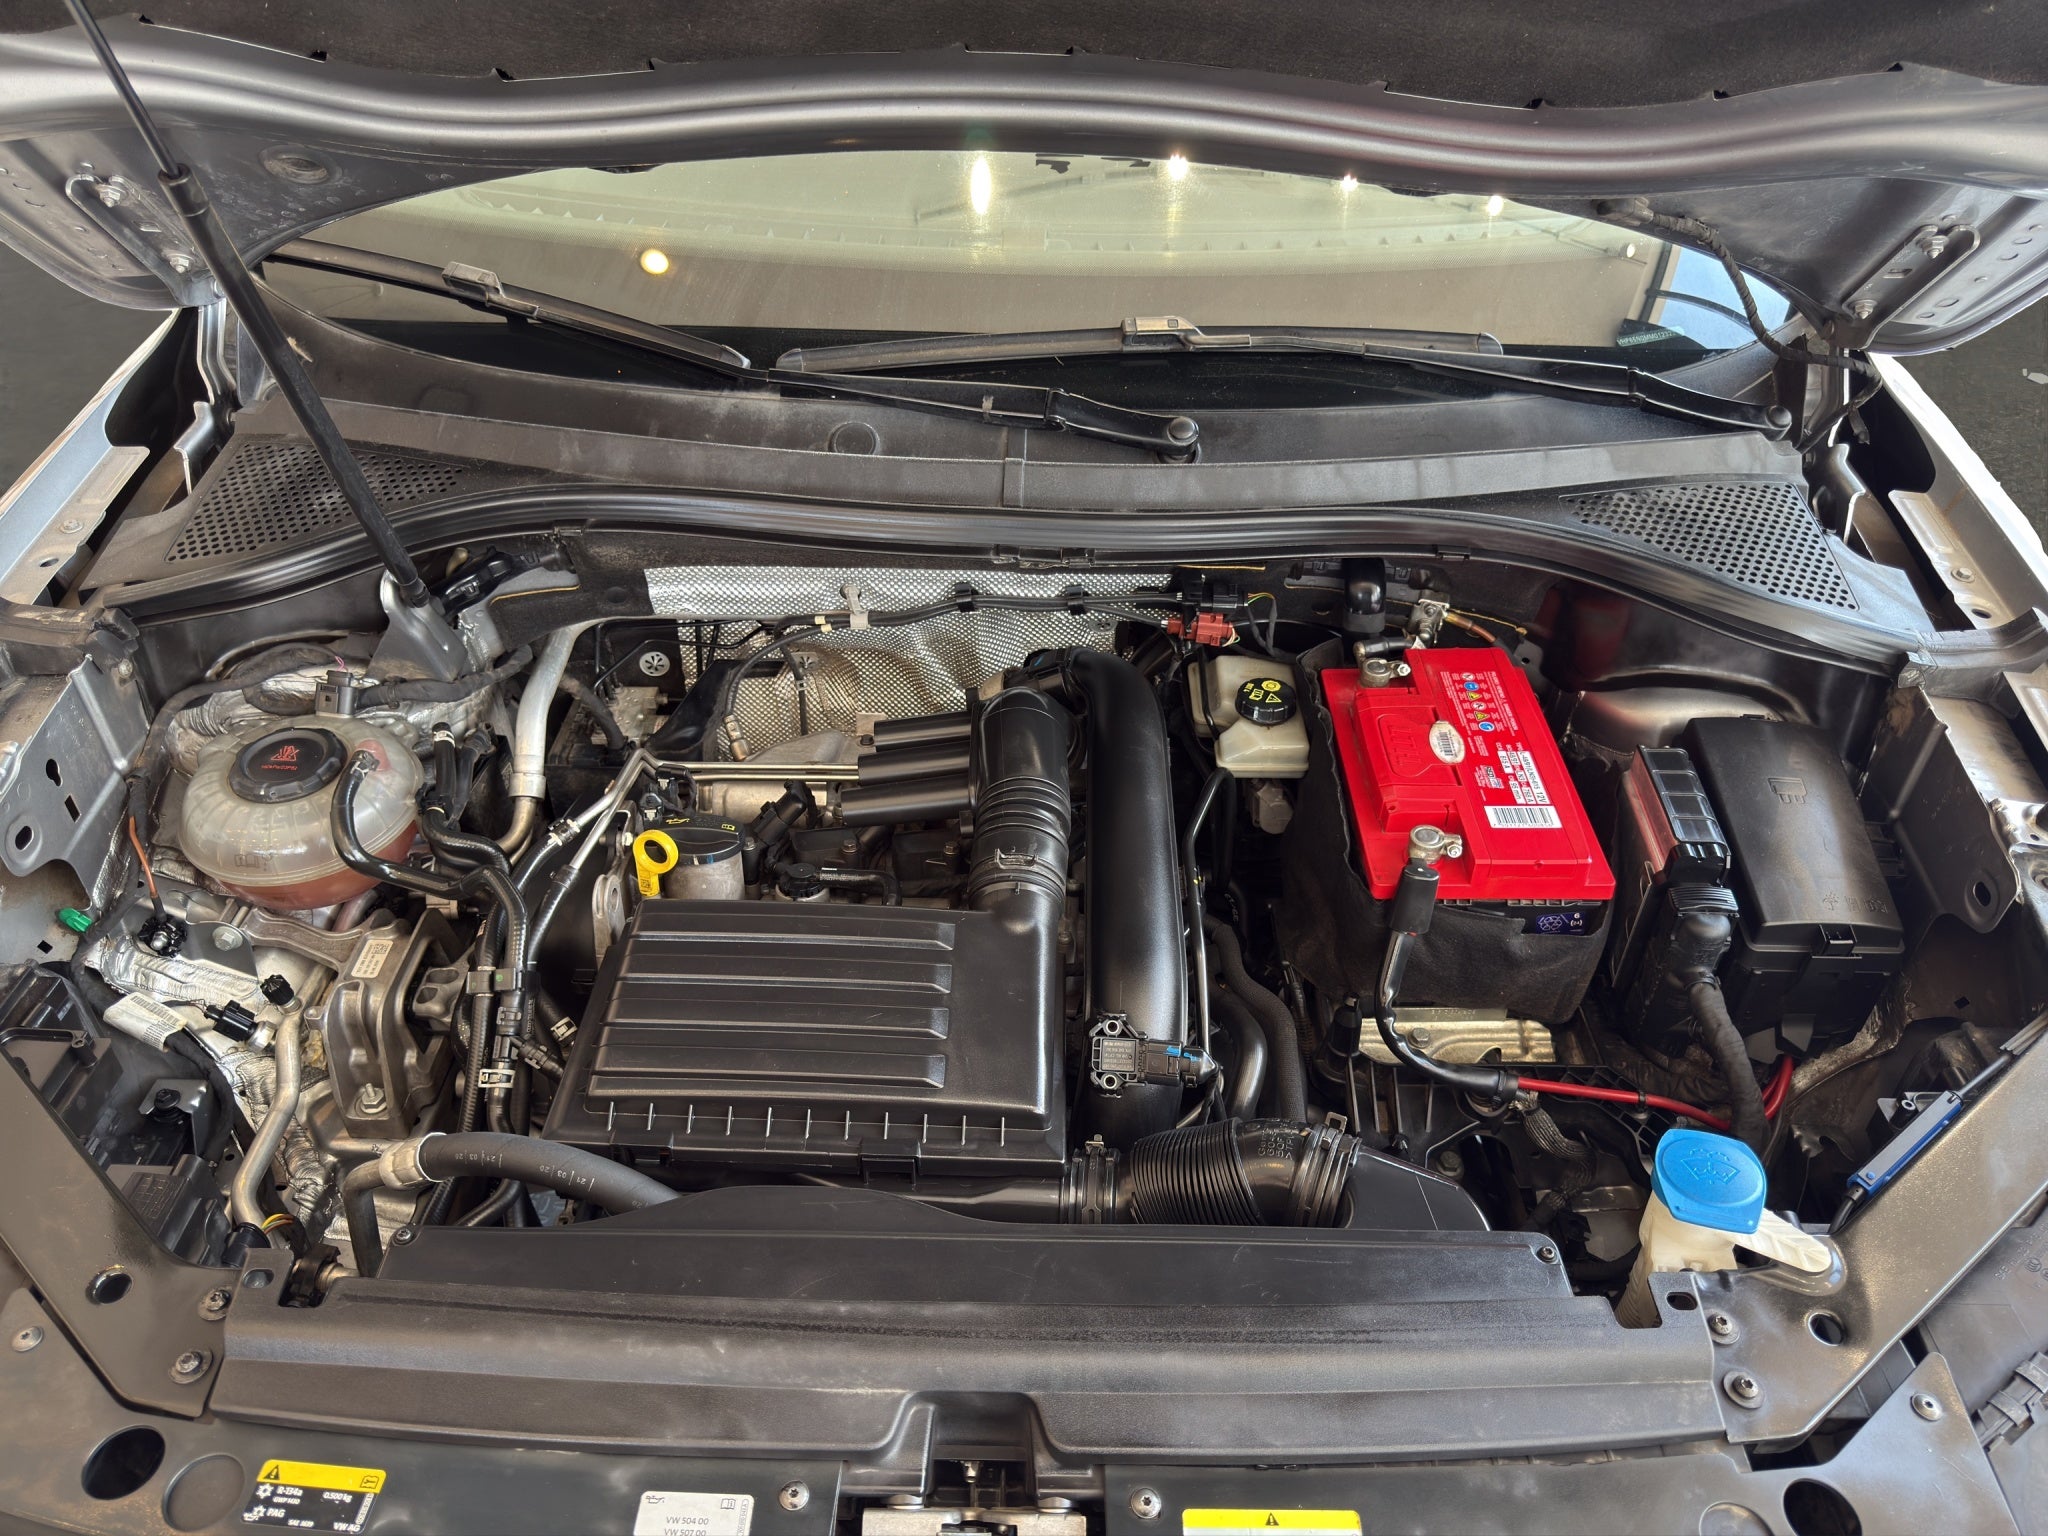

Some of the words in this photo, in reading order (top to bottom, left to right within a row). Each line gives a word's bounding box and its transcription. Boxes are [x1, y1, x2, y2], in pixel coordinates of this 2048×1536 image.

[1536, 792, 1547, 803] 12V
[266, 1508, 286, 1518] PAG
[666, 1516, 681, 1525] VW
[681, 1517, 696, 1525] 504
[697, 1517, 710, 1525] 00
[333, 1522, 348, 1531] VW
[347, 1523, 361, 1532] AG
[664, 1528, 679, 1536] VW
